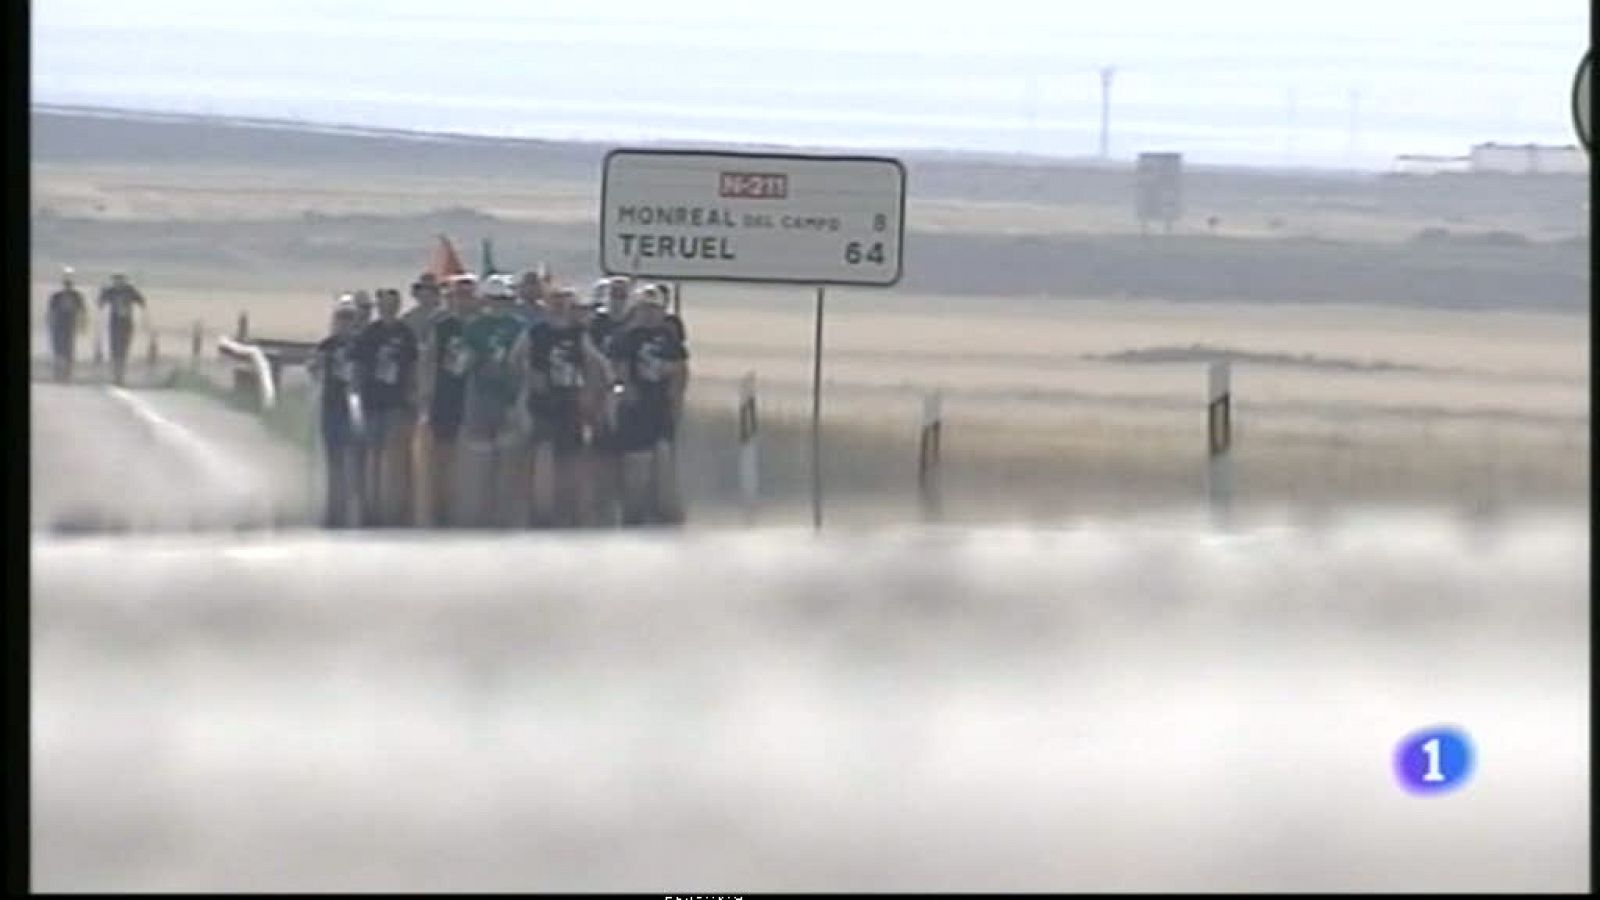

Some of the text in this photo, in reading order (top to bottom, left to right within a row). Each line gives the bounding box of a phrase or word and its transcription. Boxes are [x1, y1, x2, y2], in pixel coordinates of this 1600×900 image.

[723, 174, 785, 195] N-211
[618, 206, 736, 228] MONREAL
[618, 233, 884, 264] TERUEL 64
